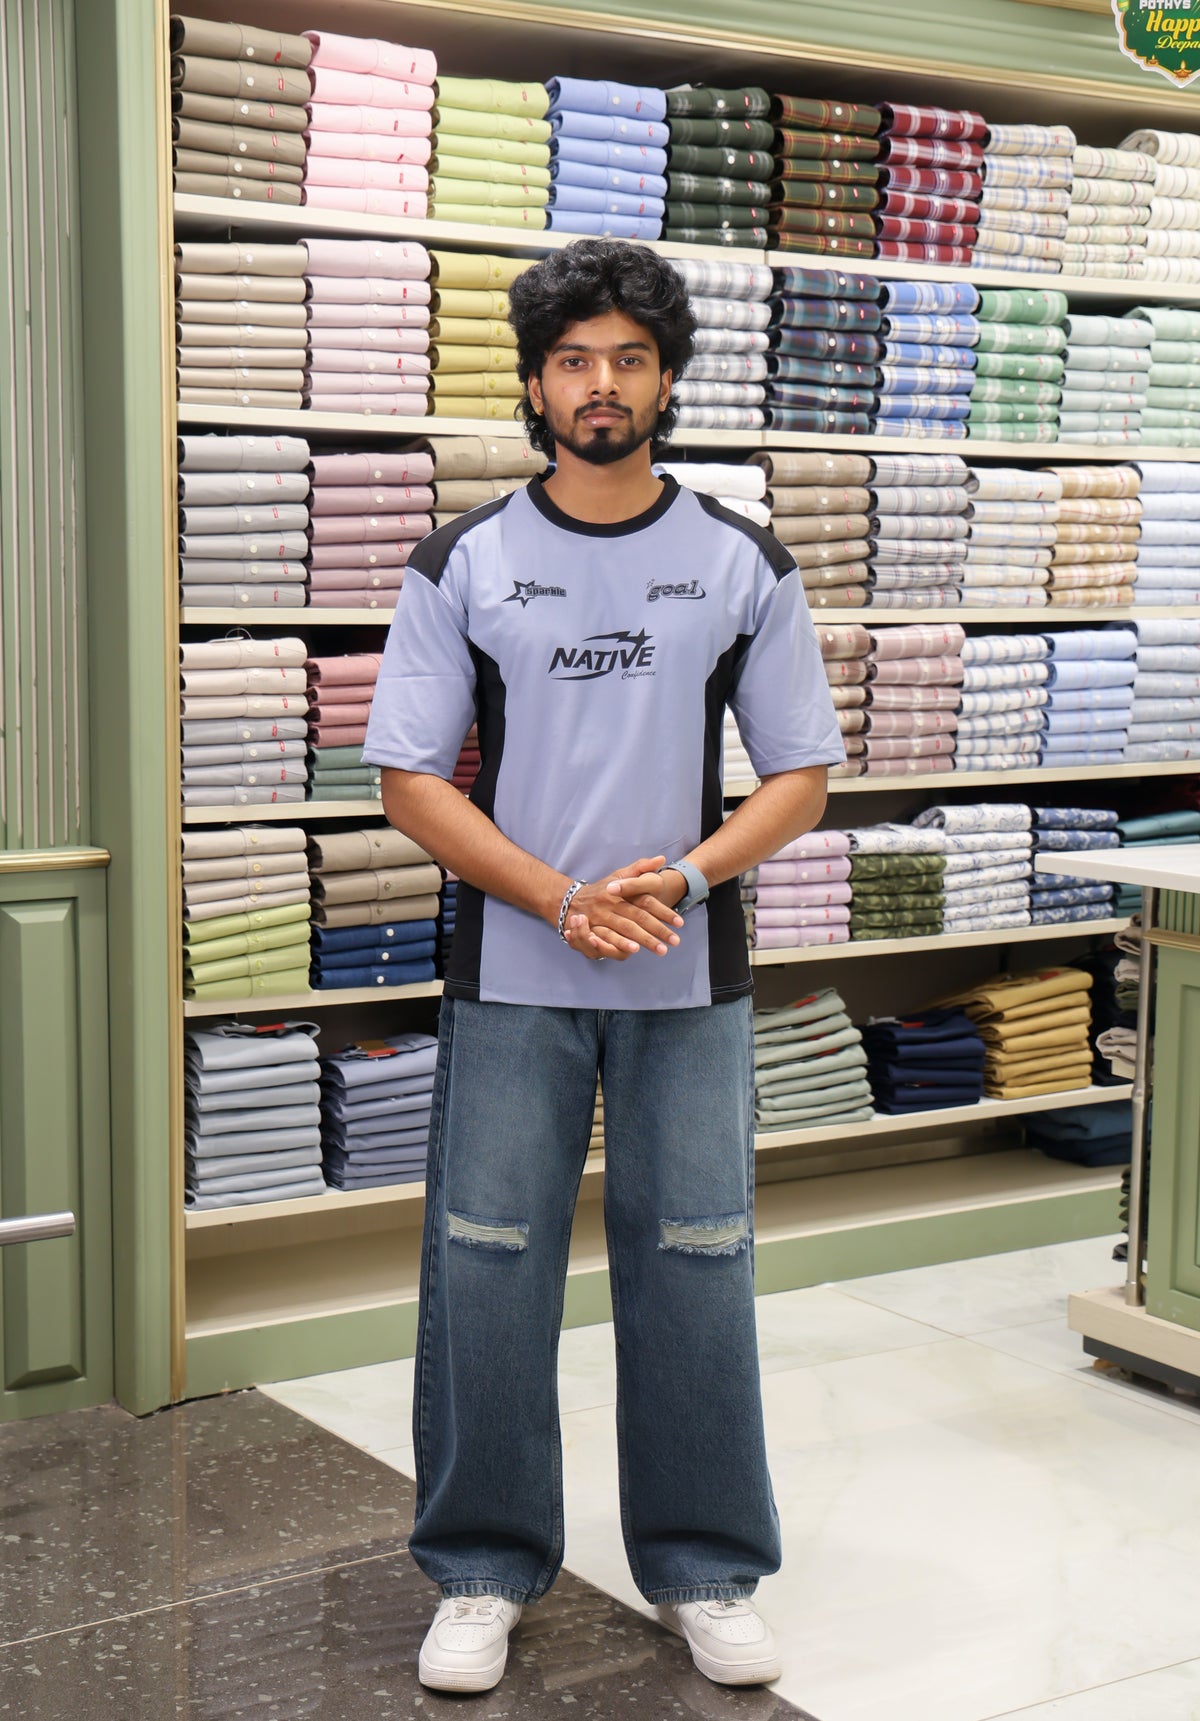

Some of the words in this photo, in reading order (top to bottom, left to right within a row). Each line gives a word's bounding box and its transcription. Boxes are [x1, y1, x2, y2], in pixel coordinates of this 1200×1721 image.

[1139, 0, 1191, 9] POTHYS
[1155, 35, 1200, 53] Deepa
[646, 579, 700, 603] goal
[548, 645, 656, 674] NATIVE
[621, 670, 657, 680] Confidence
